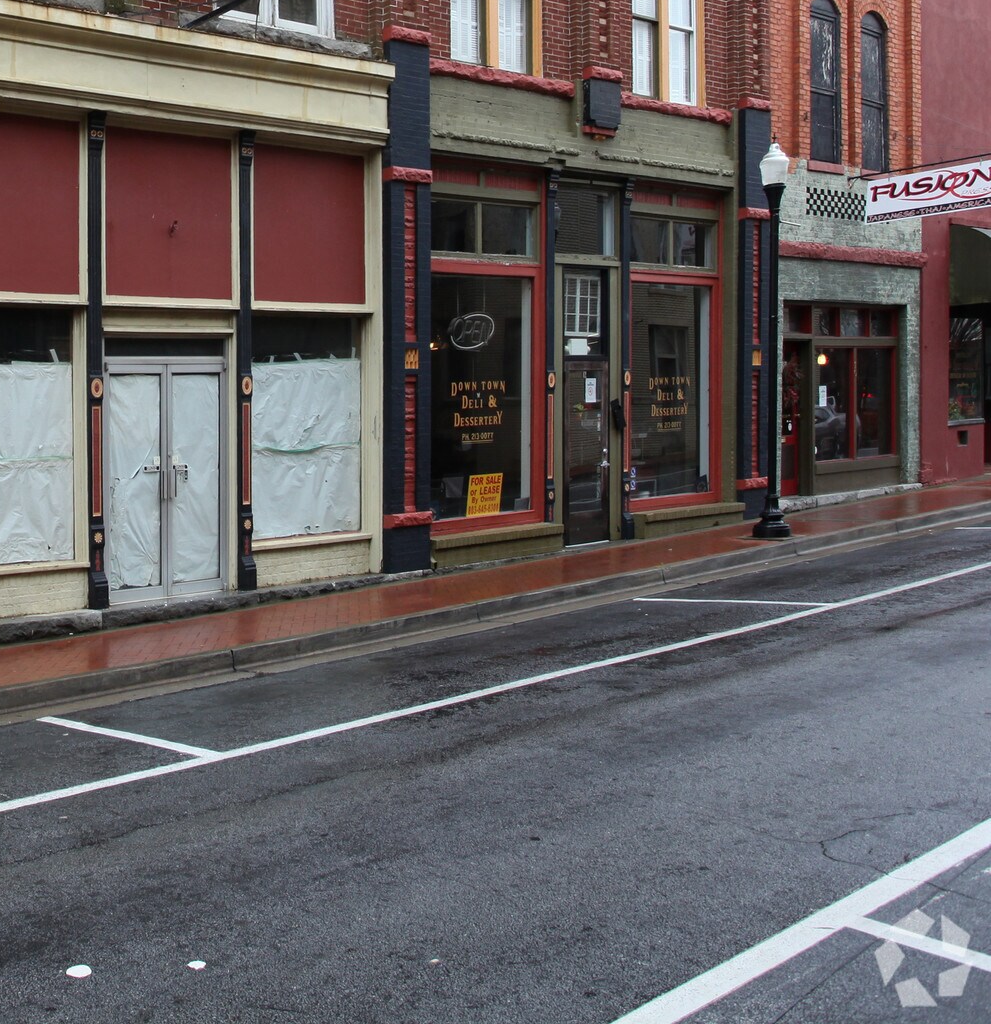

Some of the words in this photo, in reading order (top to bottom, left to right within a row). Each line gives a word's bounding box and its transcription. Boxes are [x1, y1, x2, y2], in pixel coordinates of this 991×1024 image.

[453, 318, 492, 344] OPEN
[451, 381, 477, 396] DOWN
[481, 380, 506, 393] TOWN
[649, 377, 668, 390] DOWN
[672, 376, 691, 387] TOWN
[462, 395, 483, 409] DELI
[488, 394, 498, 408] &
[657, 388, 674, 401] DELI
[677, 388, 685, 400] &
[651, 402, 689, 417] DESSERTERY
[454, 410, 503, 427] DESSERTERY
[471, 477, 484, 486] FOR
[486, 475, 502, 485] SALE
[470, 489, 477, 497] or
[480, 485, 500, 495] LEASE
